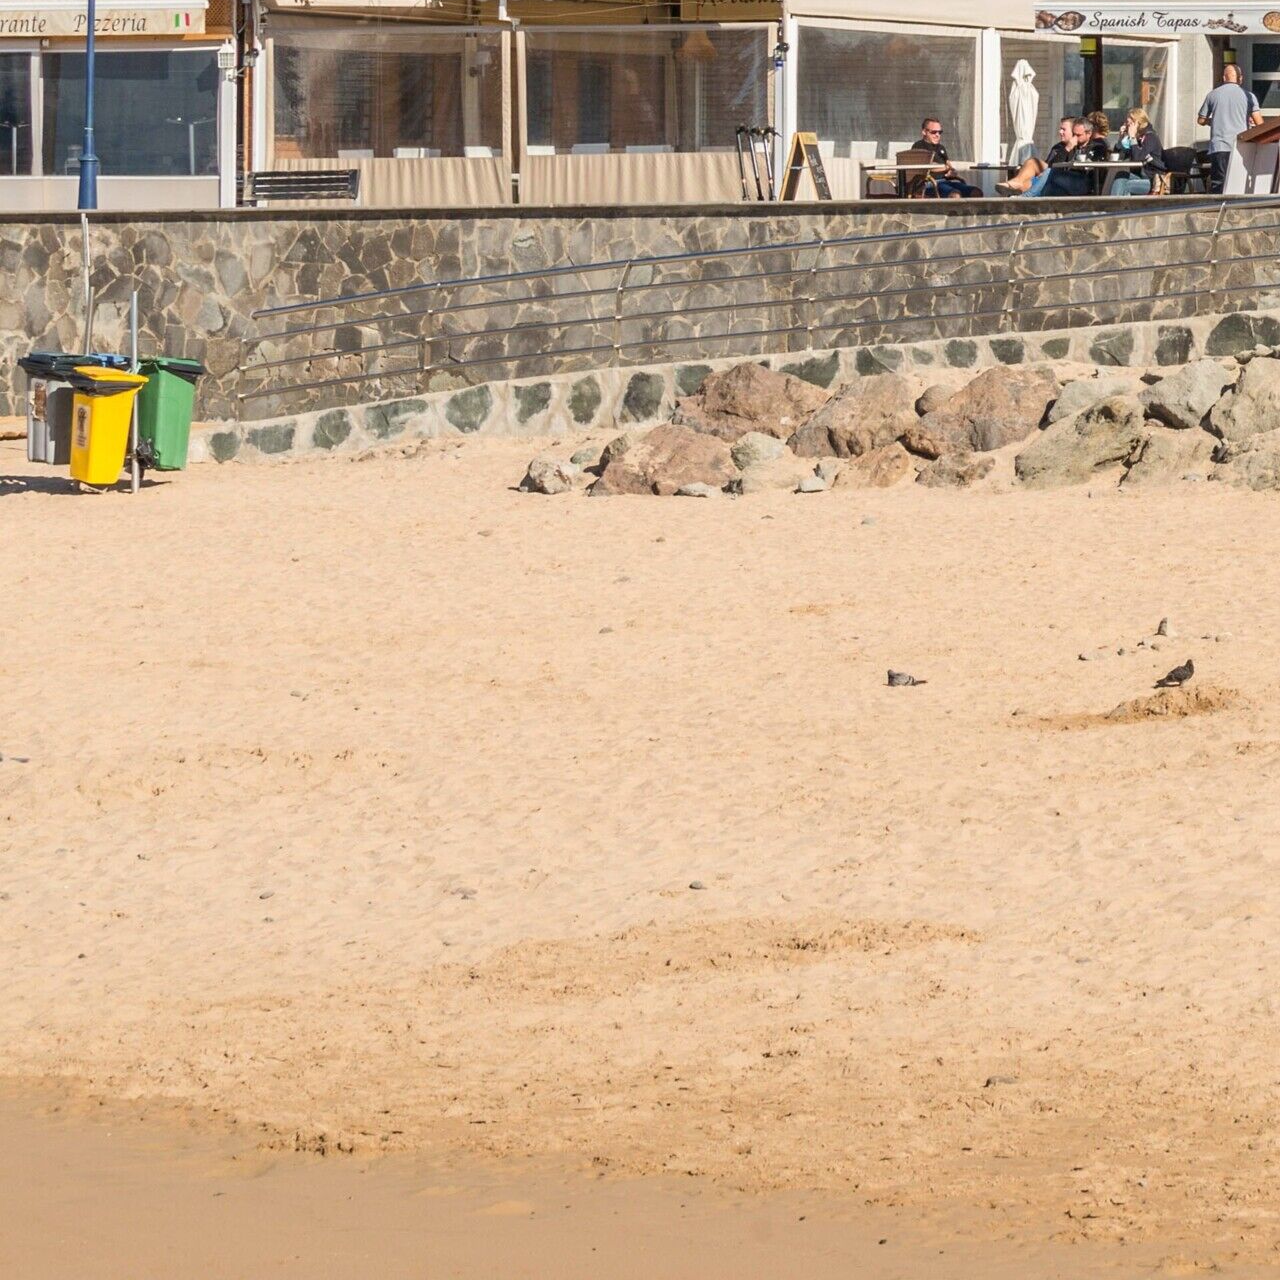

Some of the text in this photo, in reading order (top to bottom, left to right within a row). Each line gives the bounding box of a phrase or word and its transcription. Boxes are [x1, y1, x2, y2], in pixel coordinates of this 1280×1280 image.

[73, 13, 147, 33] Pzzeria
[1089, 11, 1149, 31] Spanish
[1152, 11, 1201, 32] Tapas
